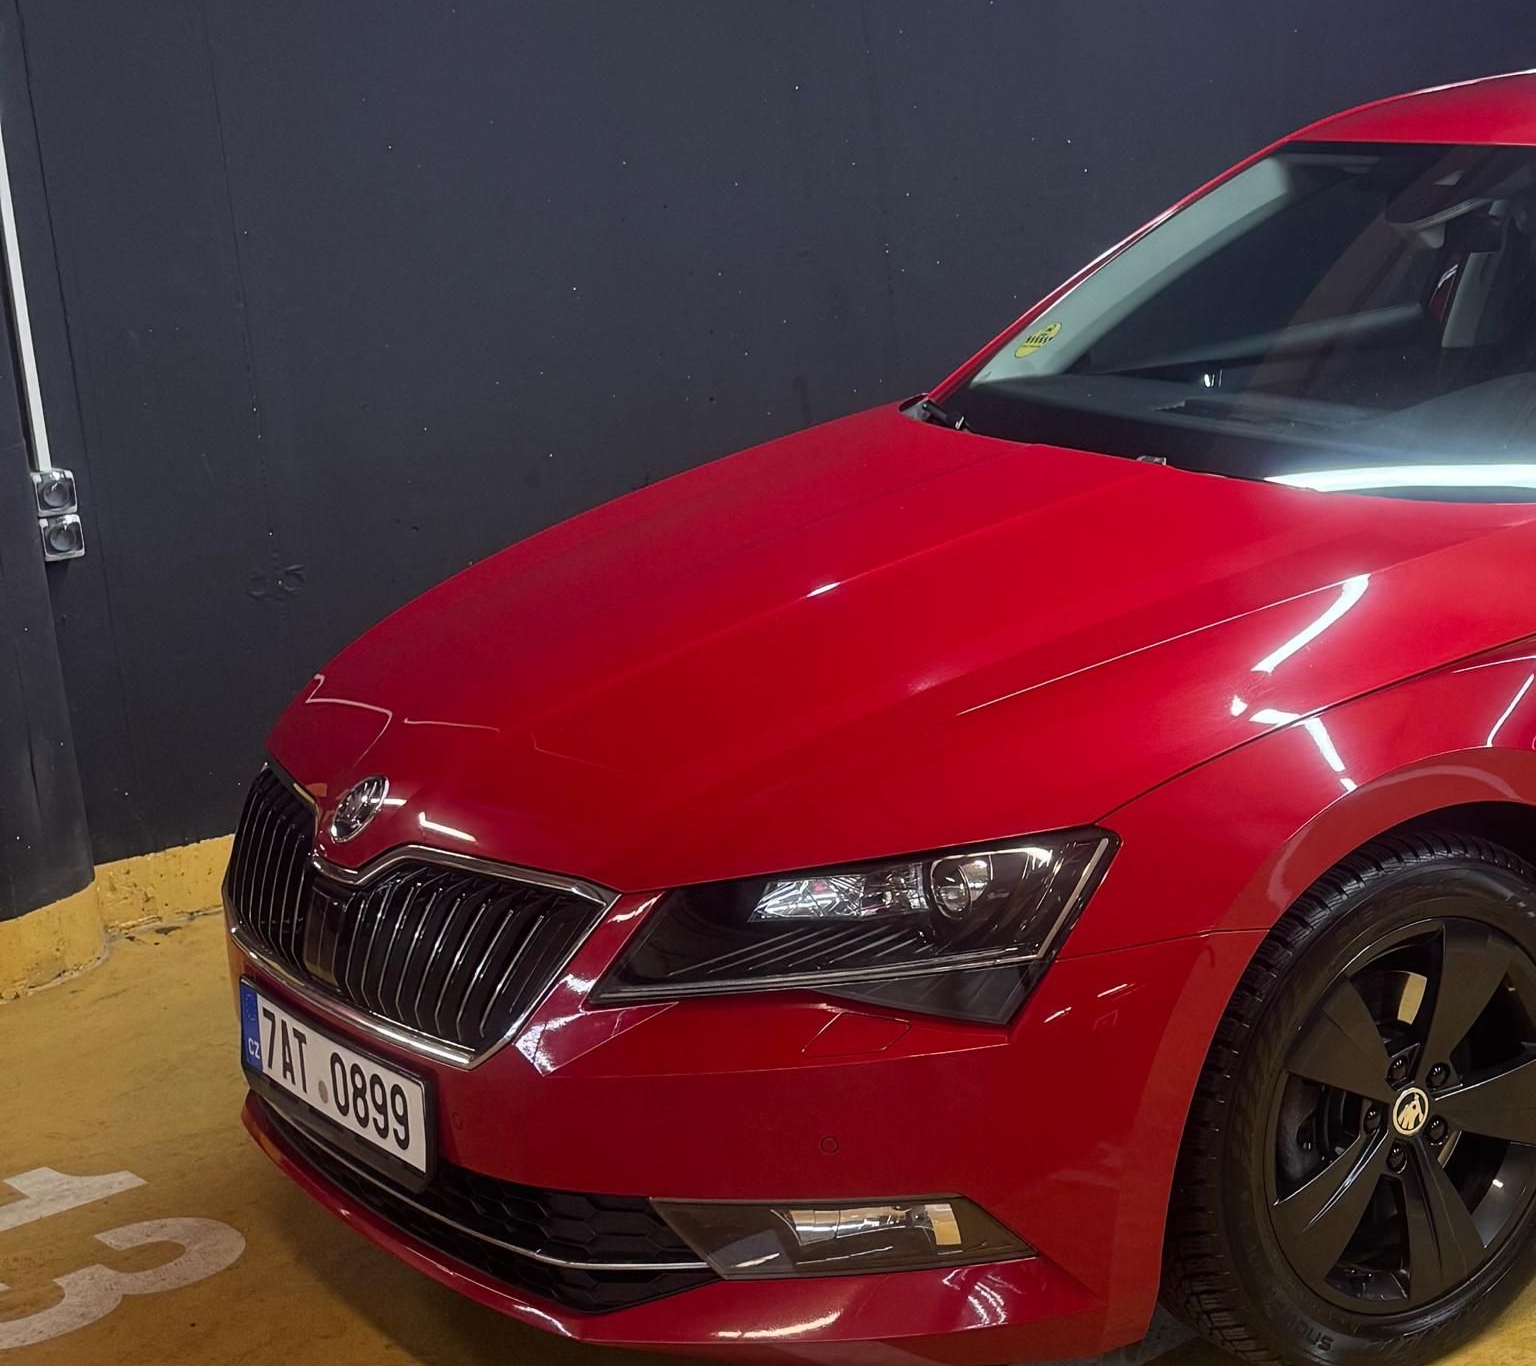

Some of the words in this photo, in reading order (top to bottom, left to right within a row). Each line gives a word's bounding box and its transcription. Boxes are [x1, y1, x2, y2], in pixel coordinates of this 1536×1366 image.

[248, 1037, 261, 1060] CZ
[262, 1007, 307, 1093] 7AT
[330, 1051, 410, 1151] 0899
